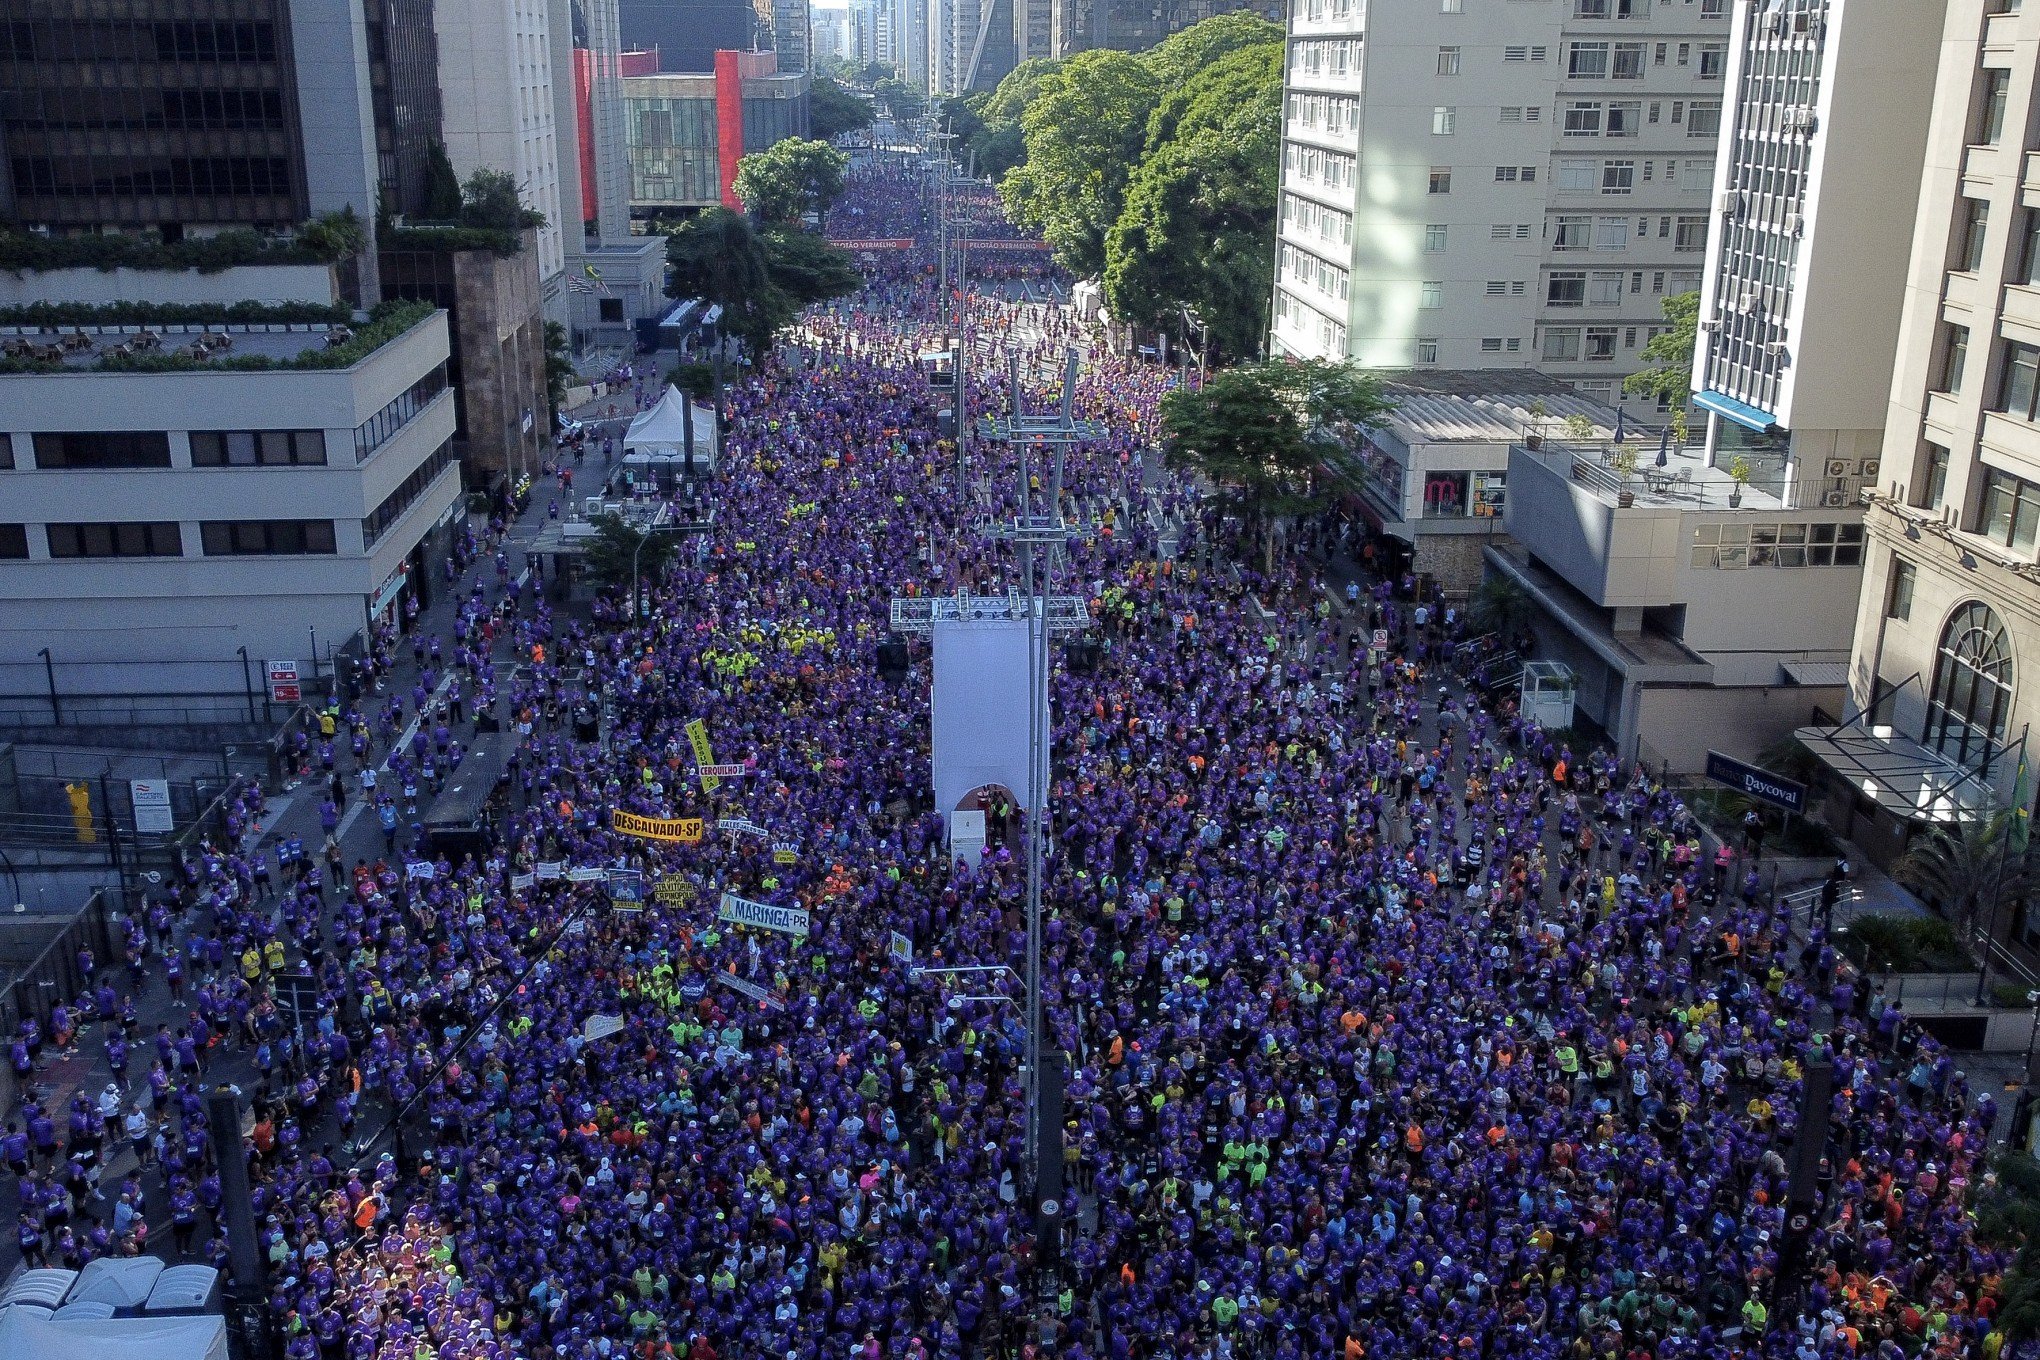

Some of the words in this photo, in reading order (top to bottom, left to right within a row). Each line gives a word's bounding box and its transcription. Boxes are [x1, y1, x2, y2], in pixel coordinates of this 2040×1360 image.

[969, 241, 999, 249] PELOTÃO
[700, 766, 738, 776] CERQUILHO
[1745, 774, 1797, 803] Daycoval
[614, 813, 700, 837] DESCALVADO-SP
